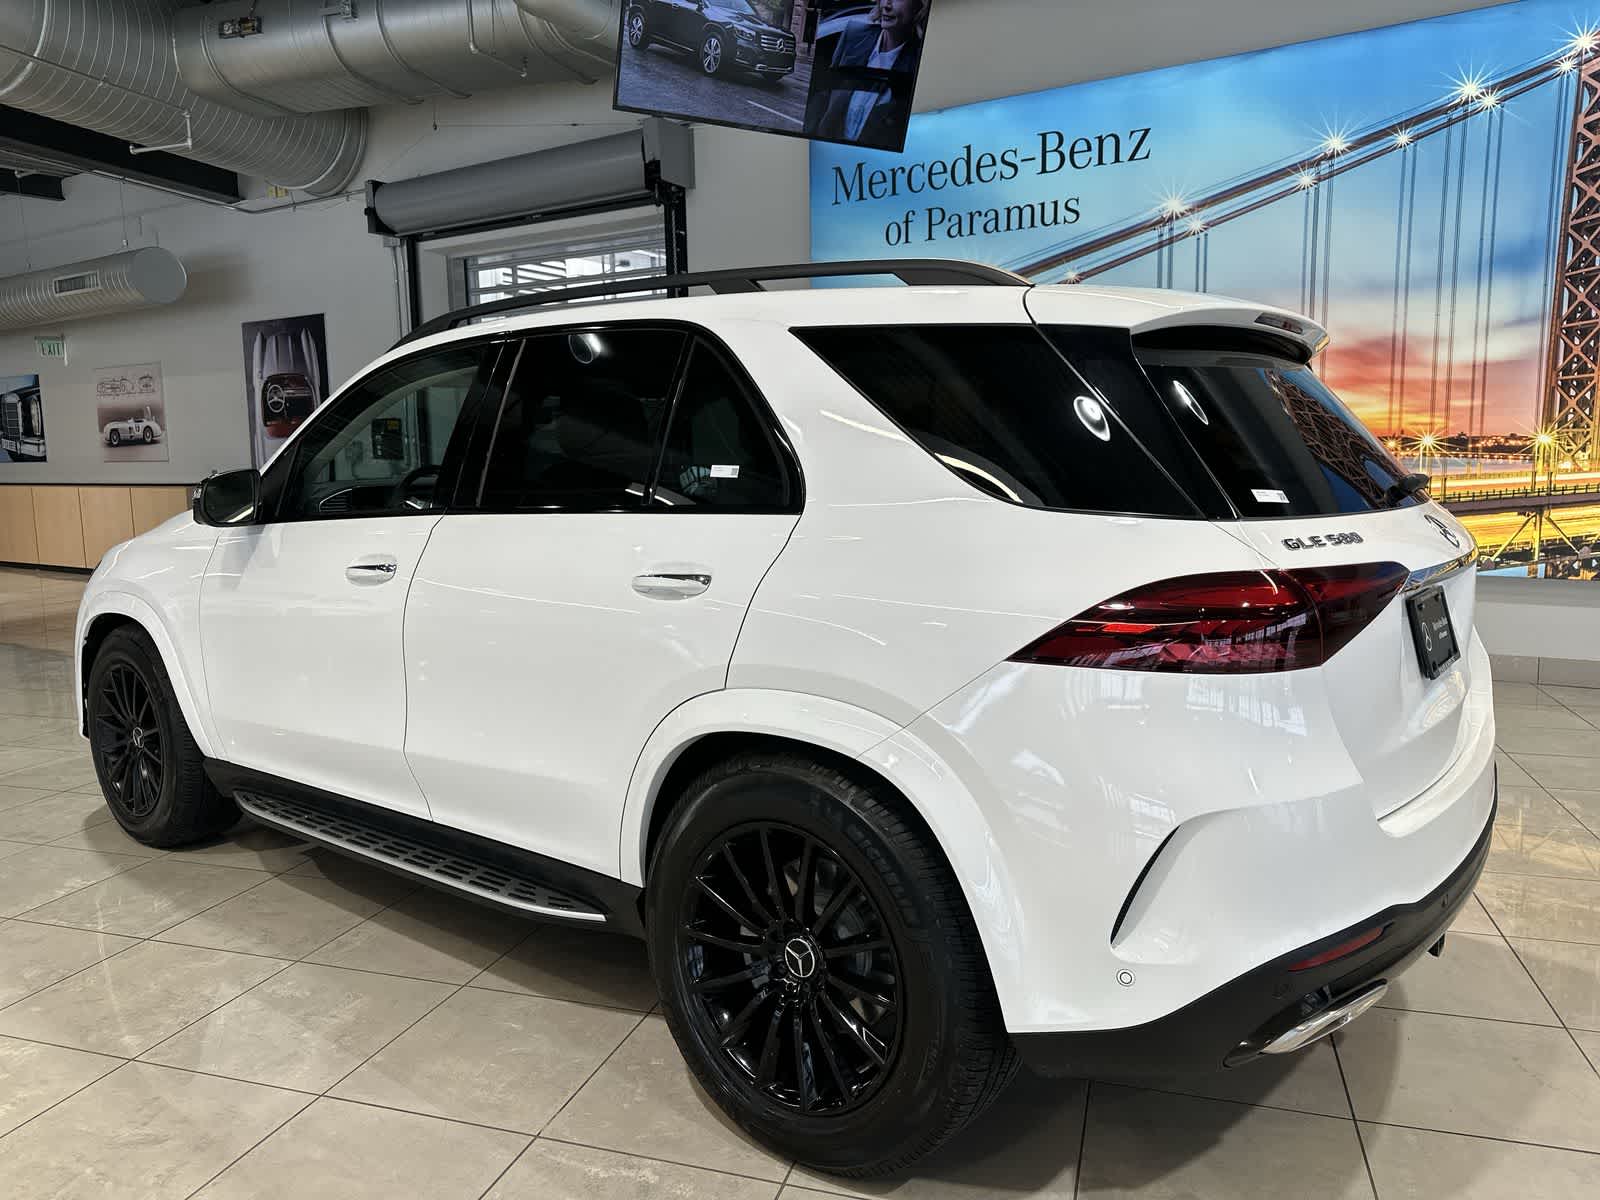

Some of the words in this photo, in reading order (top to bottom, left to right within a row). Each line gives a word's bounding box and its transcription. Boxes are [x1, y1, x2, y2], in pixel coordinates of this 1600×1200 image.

[831, 127, 1152, 206] Mercedes-Benz
[885, 209, 916, 246] of
[924, 196, 1081, 242] Paramus
[1281, 535, 1327, 551] GLE
